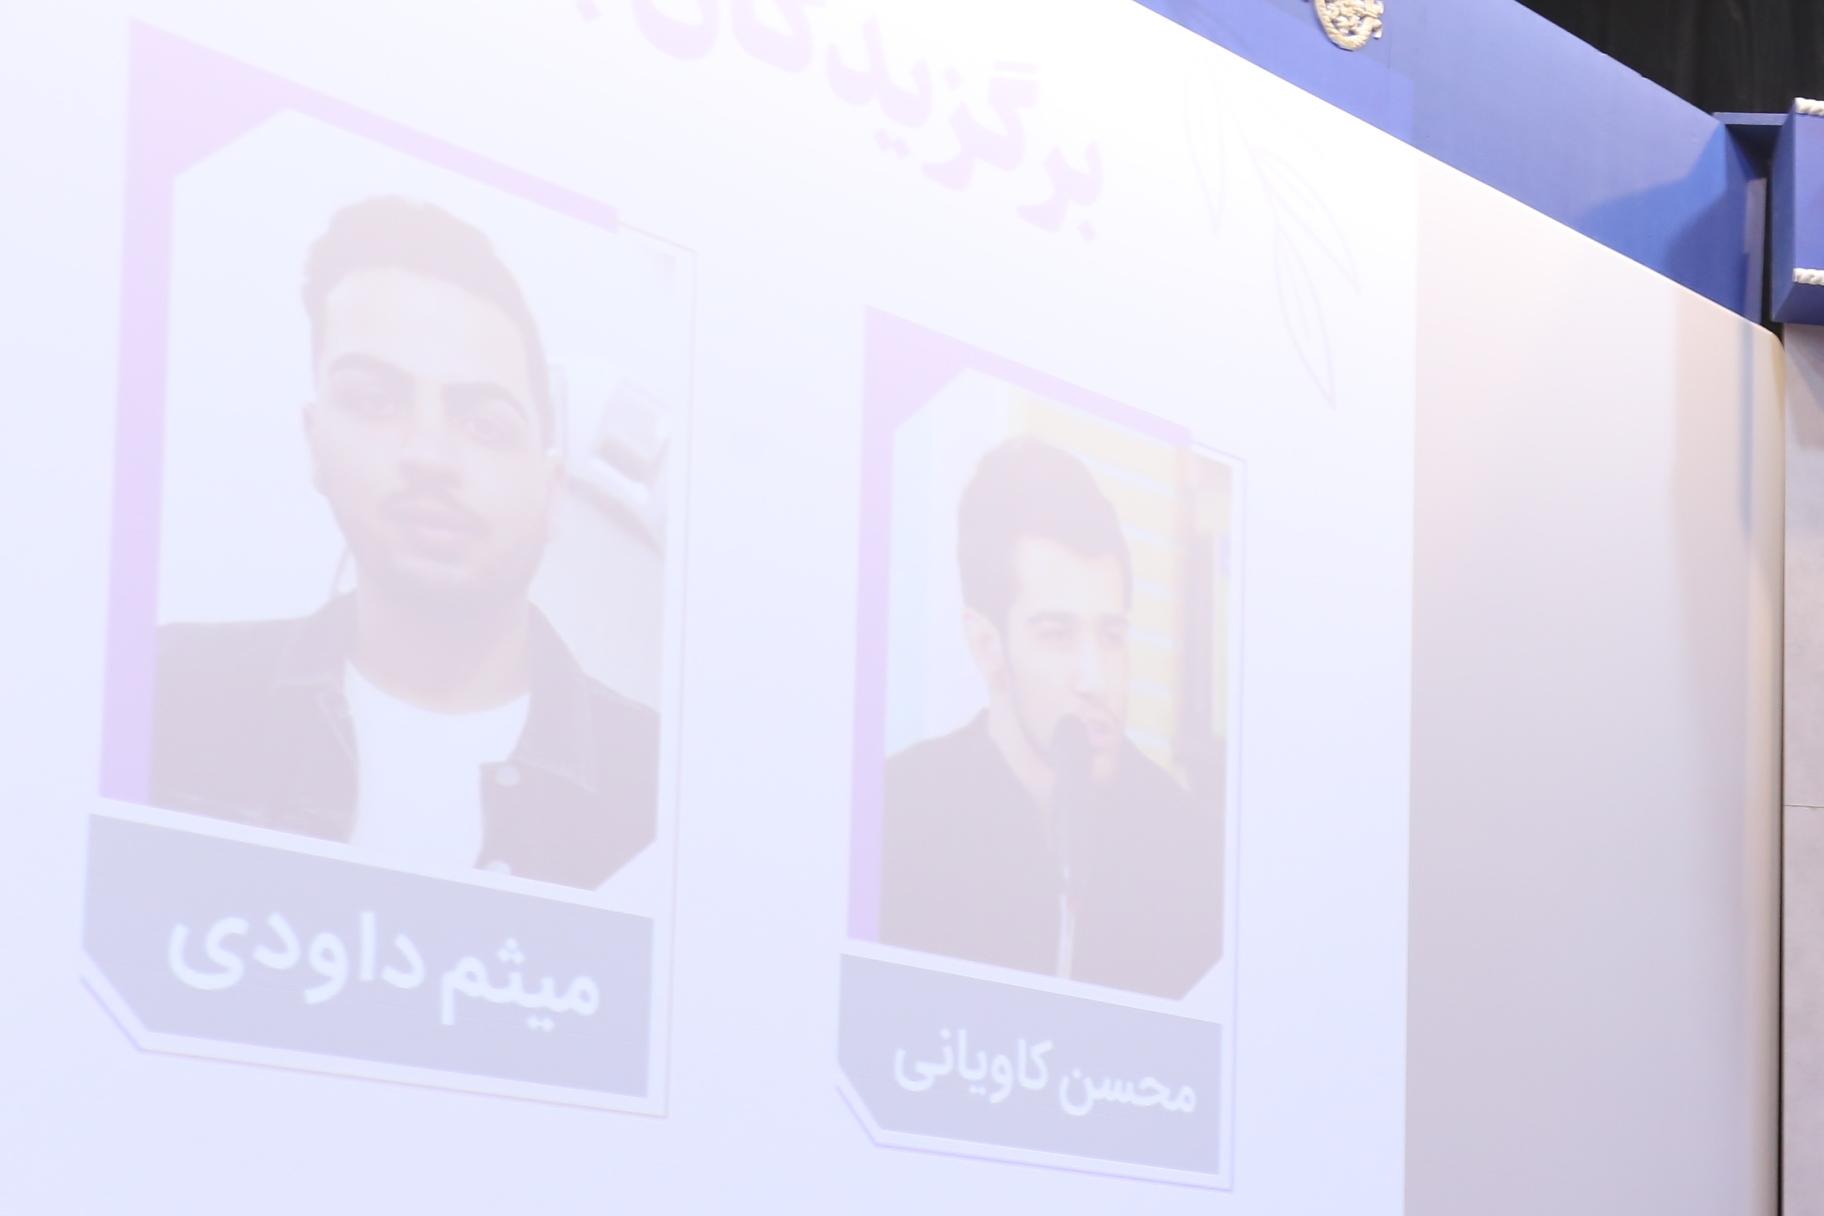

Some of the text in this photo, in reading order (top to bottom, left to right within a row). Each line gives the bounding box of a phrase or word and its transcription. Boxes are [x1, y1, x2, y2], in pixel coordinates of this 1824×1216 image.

[168, 910, 600, 1032] میثم داودی
[894, 1027, 1197, 1116] محسن کاویانی
